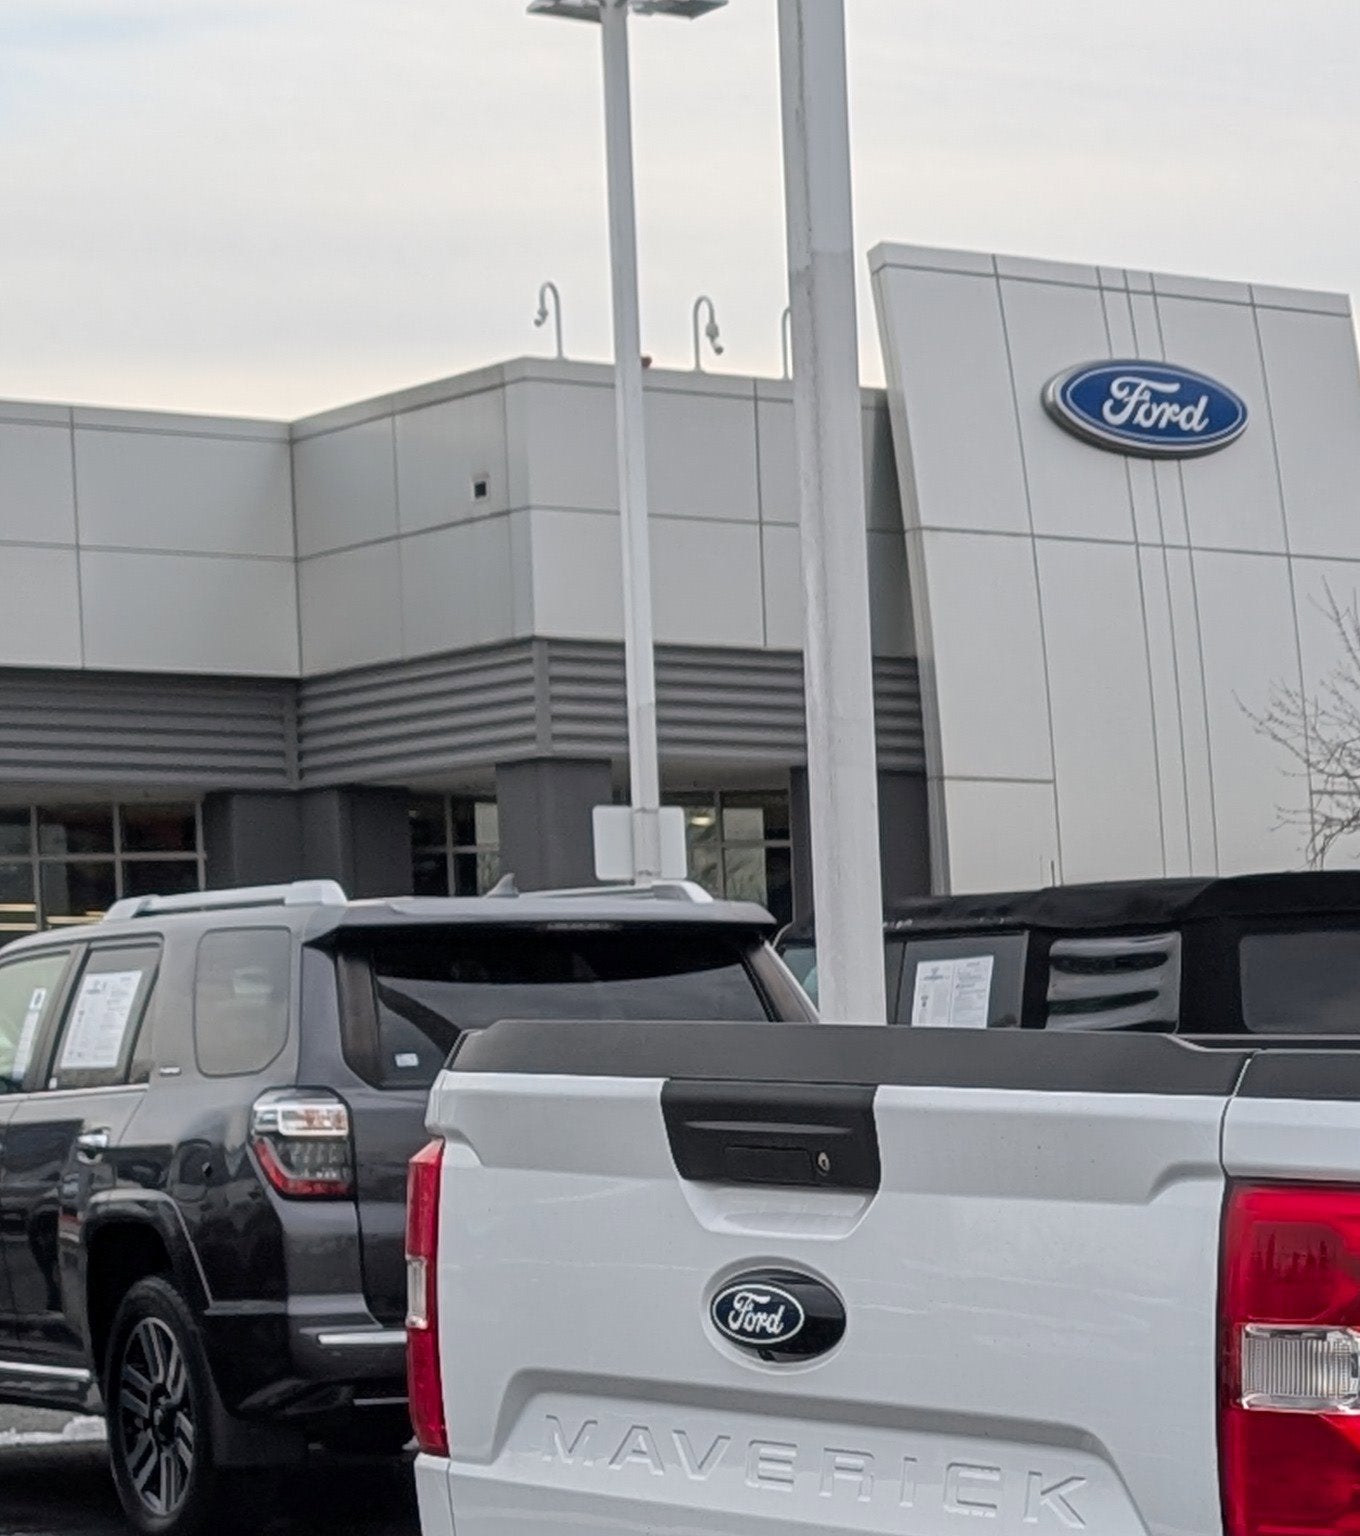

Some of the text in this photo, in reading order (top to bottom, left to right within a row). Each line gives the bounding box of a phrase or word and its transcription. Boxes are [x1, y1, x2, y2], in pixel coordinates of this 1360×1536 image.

[1102, 376, 1209, 432] Ford
[728, 1291, 785, 1335] Ford
[541, 1413, 1087, 1530] MAVERICK
